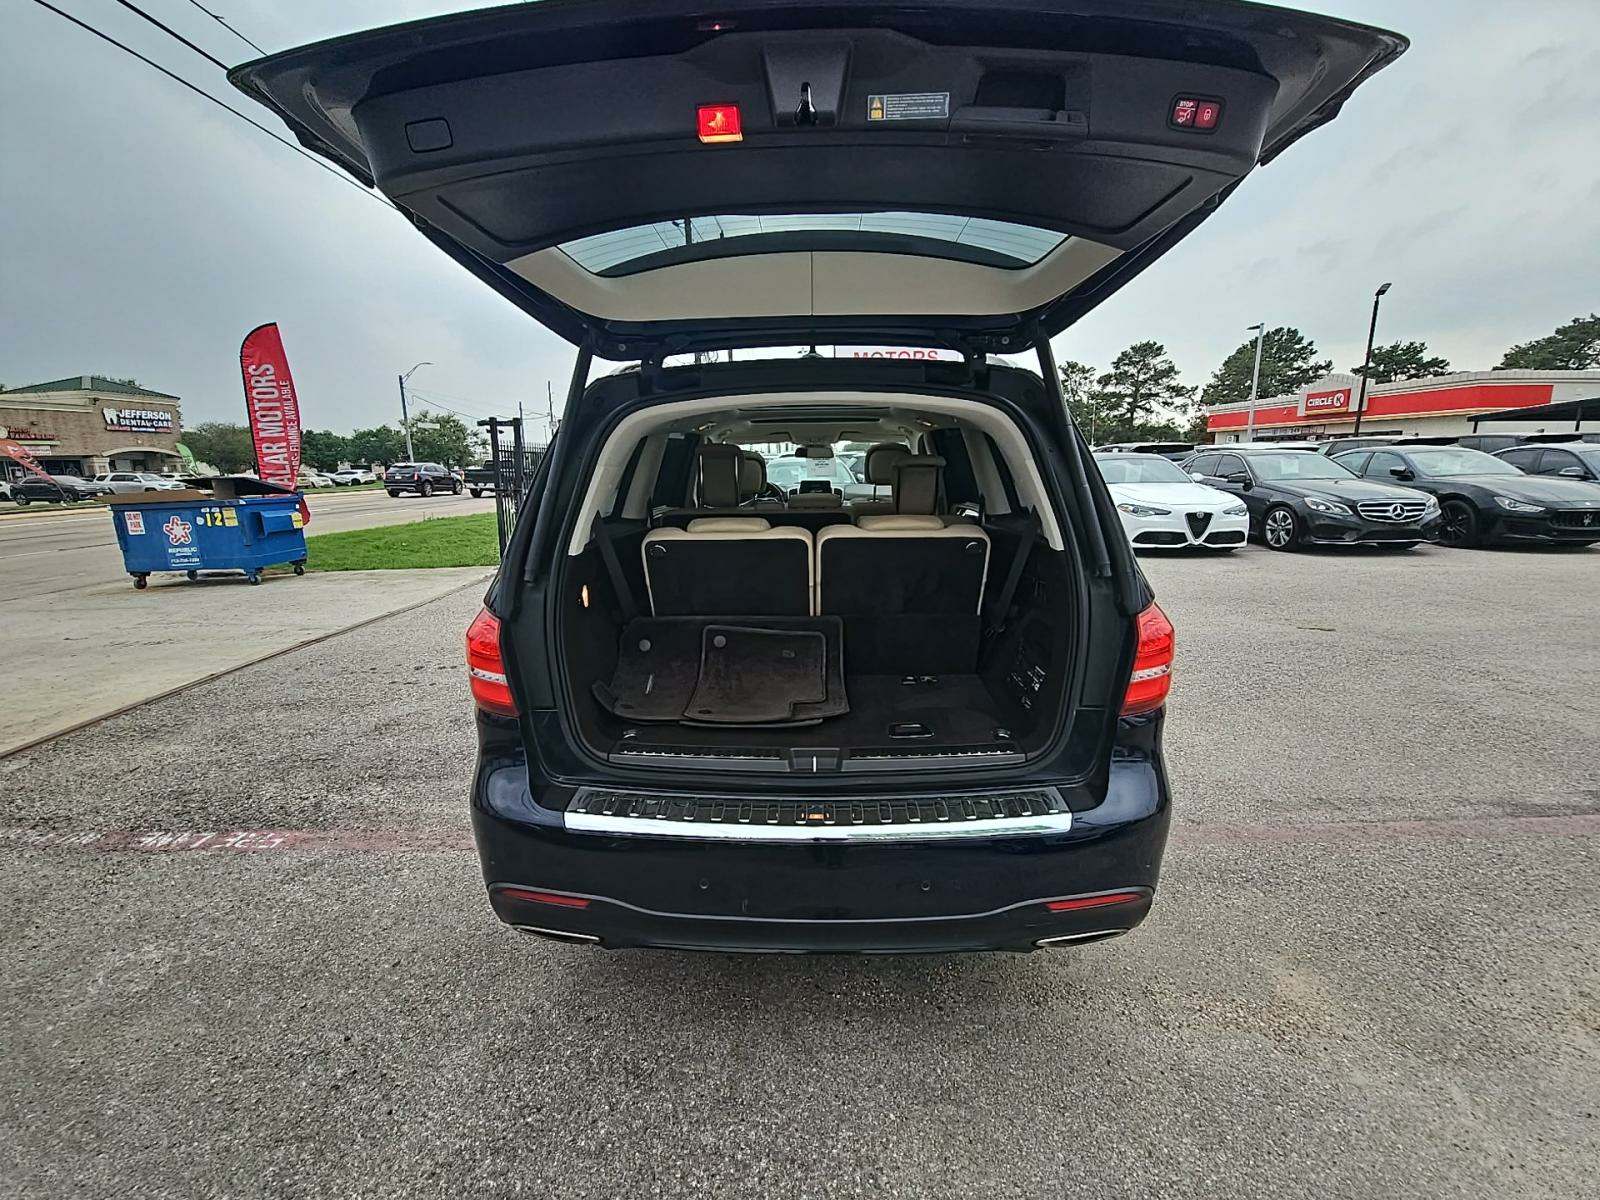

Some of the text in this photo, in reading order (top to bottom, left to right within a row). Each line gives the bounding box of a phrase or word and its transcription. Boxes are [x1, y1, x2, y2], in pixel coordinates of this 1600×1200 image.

[853, 350, 938, 360] MOTORS
[279, 380, 296, 420] AVAILABLE
[1308, 397, 1333, 406] CIRCLE
[119, 409, 172, 420] JEFFERSON
[248, 364, 295, 491] ALAR MOTORS
[287, 421, 300, 452] FINANCE
